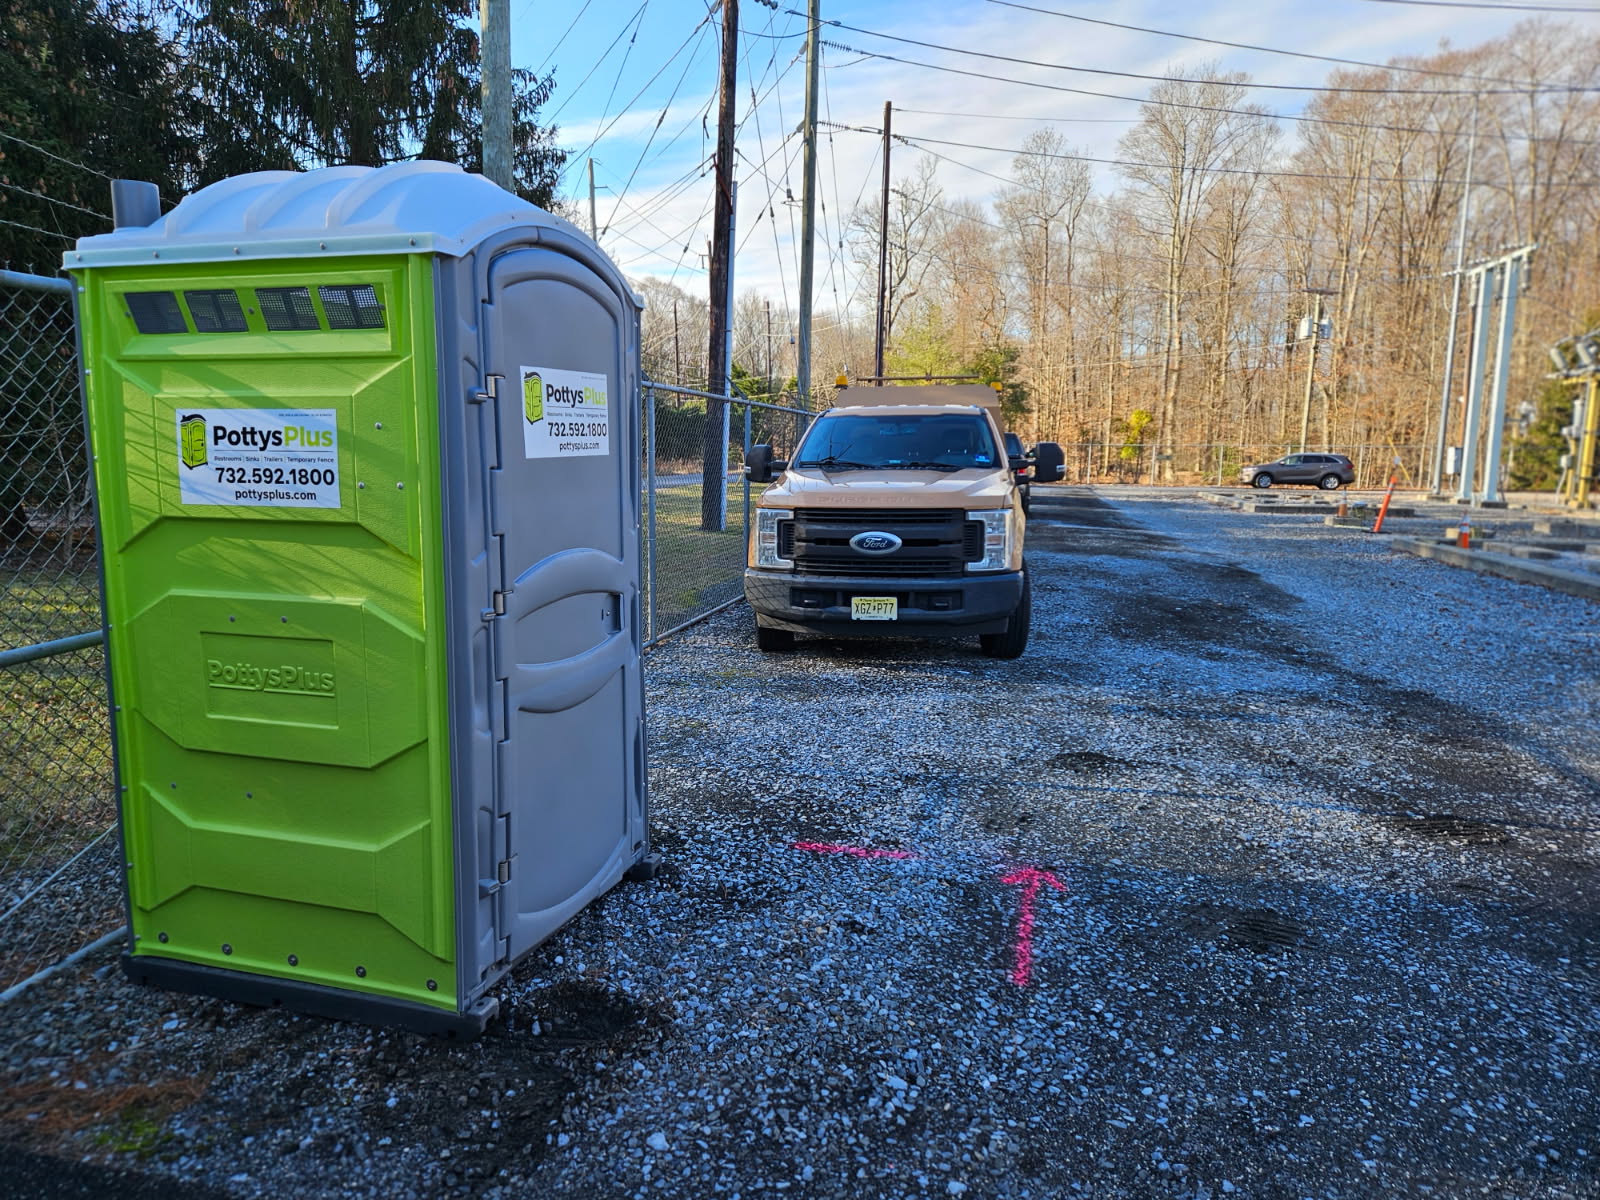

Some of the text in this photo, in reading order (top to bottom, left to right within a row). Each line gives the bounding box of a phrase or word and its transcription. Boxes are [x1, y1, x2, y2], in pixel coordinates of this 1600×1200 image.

[546, 383, 606, 408] PottysPlus
[547, 422, 607, 437] 732.592.1800
[213, 425, 333, 451] PottysPlus
[559, 441, 600, 452] pottysplus.com
[287, 456, 316, 464] Temporary
[215, 467, 335, 486] 732.592.1800
[235, 489, 317, 501] pottysplus.com
[863, 537, 888, 548] Ford
[207, 659, 335, 691] PottysPlus
